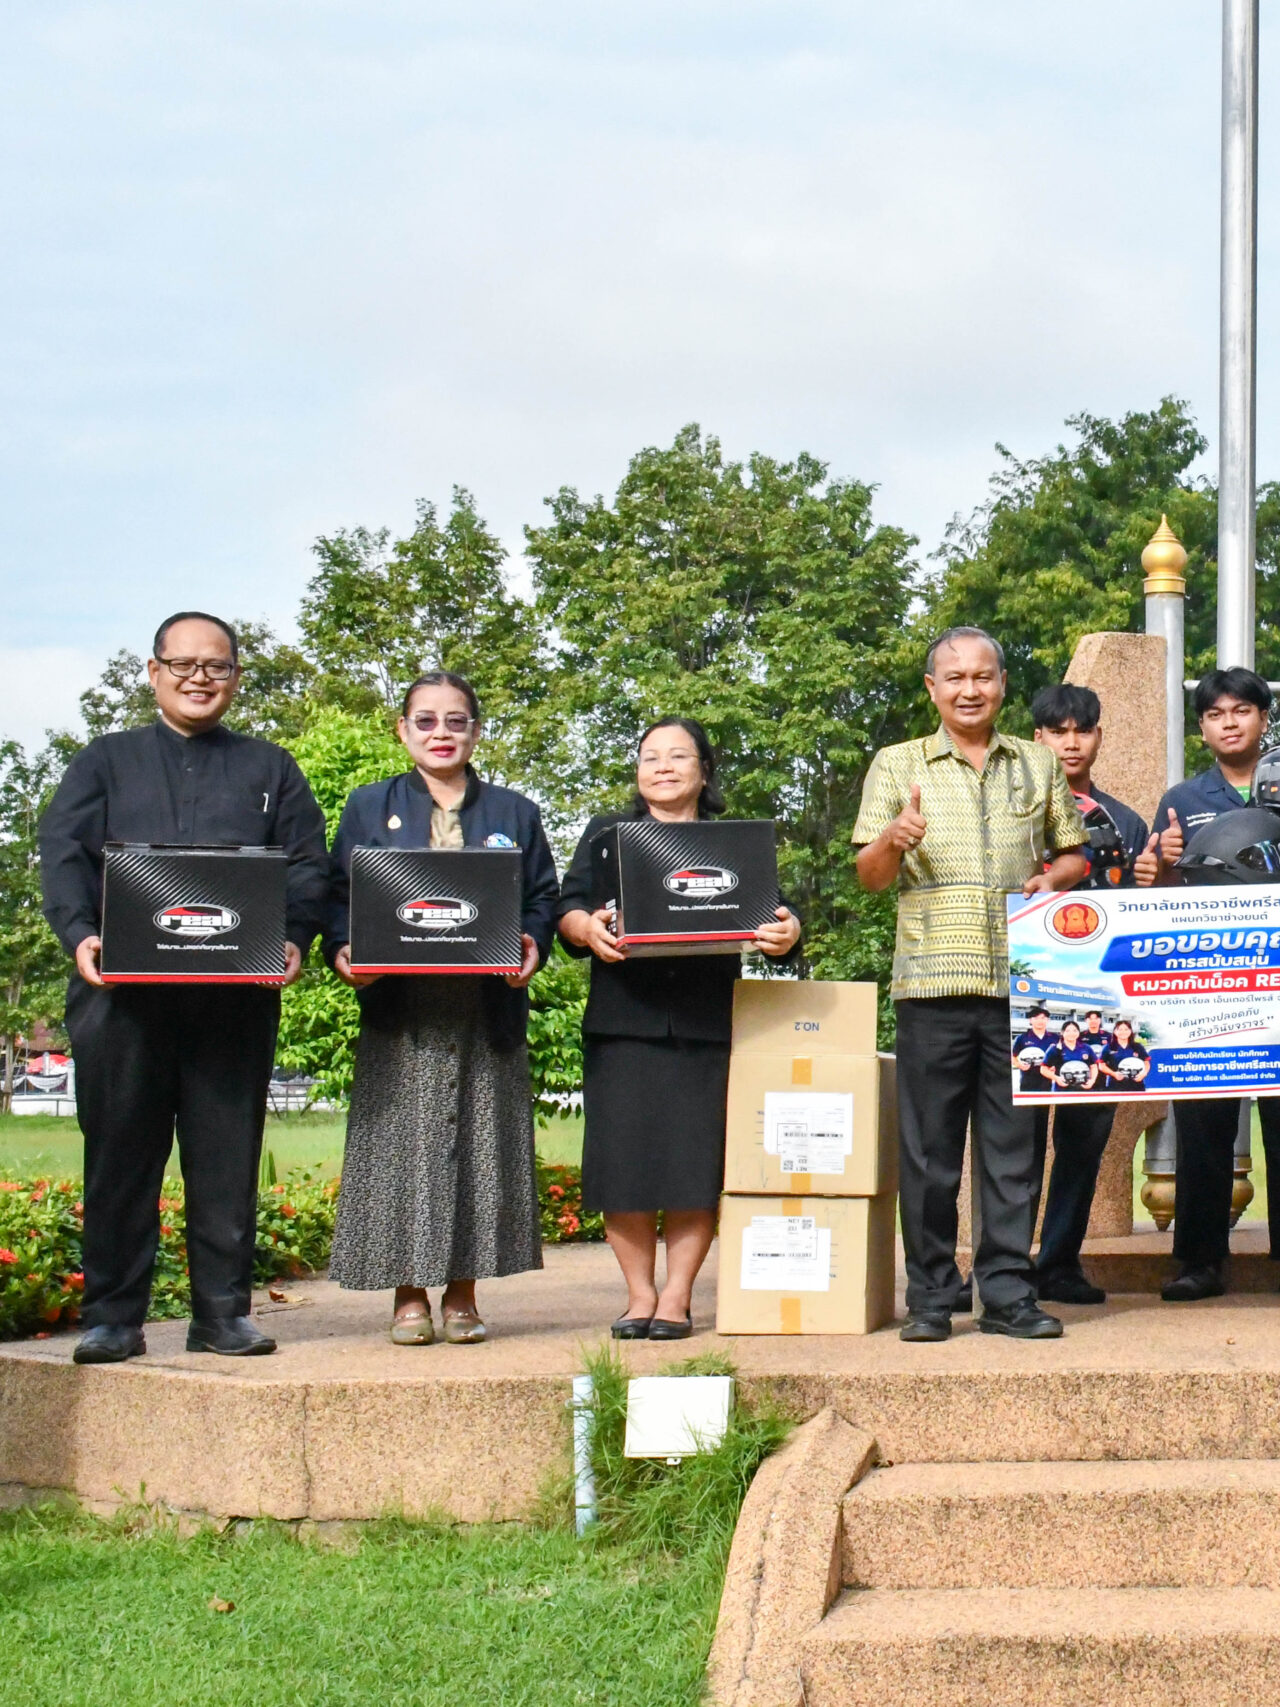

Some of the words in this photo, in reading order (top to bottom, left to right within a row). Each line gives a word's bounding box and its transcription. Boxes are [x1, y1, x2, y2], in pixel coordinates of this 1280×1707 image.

[1171, 911, 1268, 924] แผนกวิชาช่างยนต์
[1165, 953, 1270, 970] การสนับสนุน
[1133, 972, 1249, 992] หมวกกันน็อค
[1160, 996, 1186, 1006] บริษัท
[1189, 995, 1210, 1005] เรียล
[1179, 1007, 1260, 1028] เดินทางปลอดภัย
[1188, 1018, 1264, 1038] สร้างวินัยจราจร
